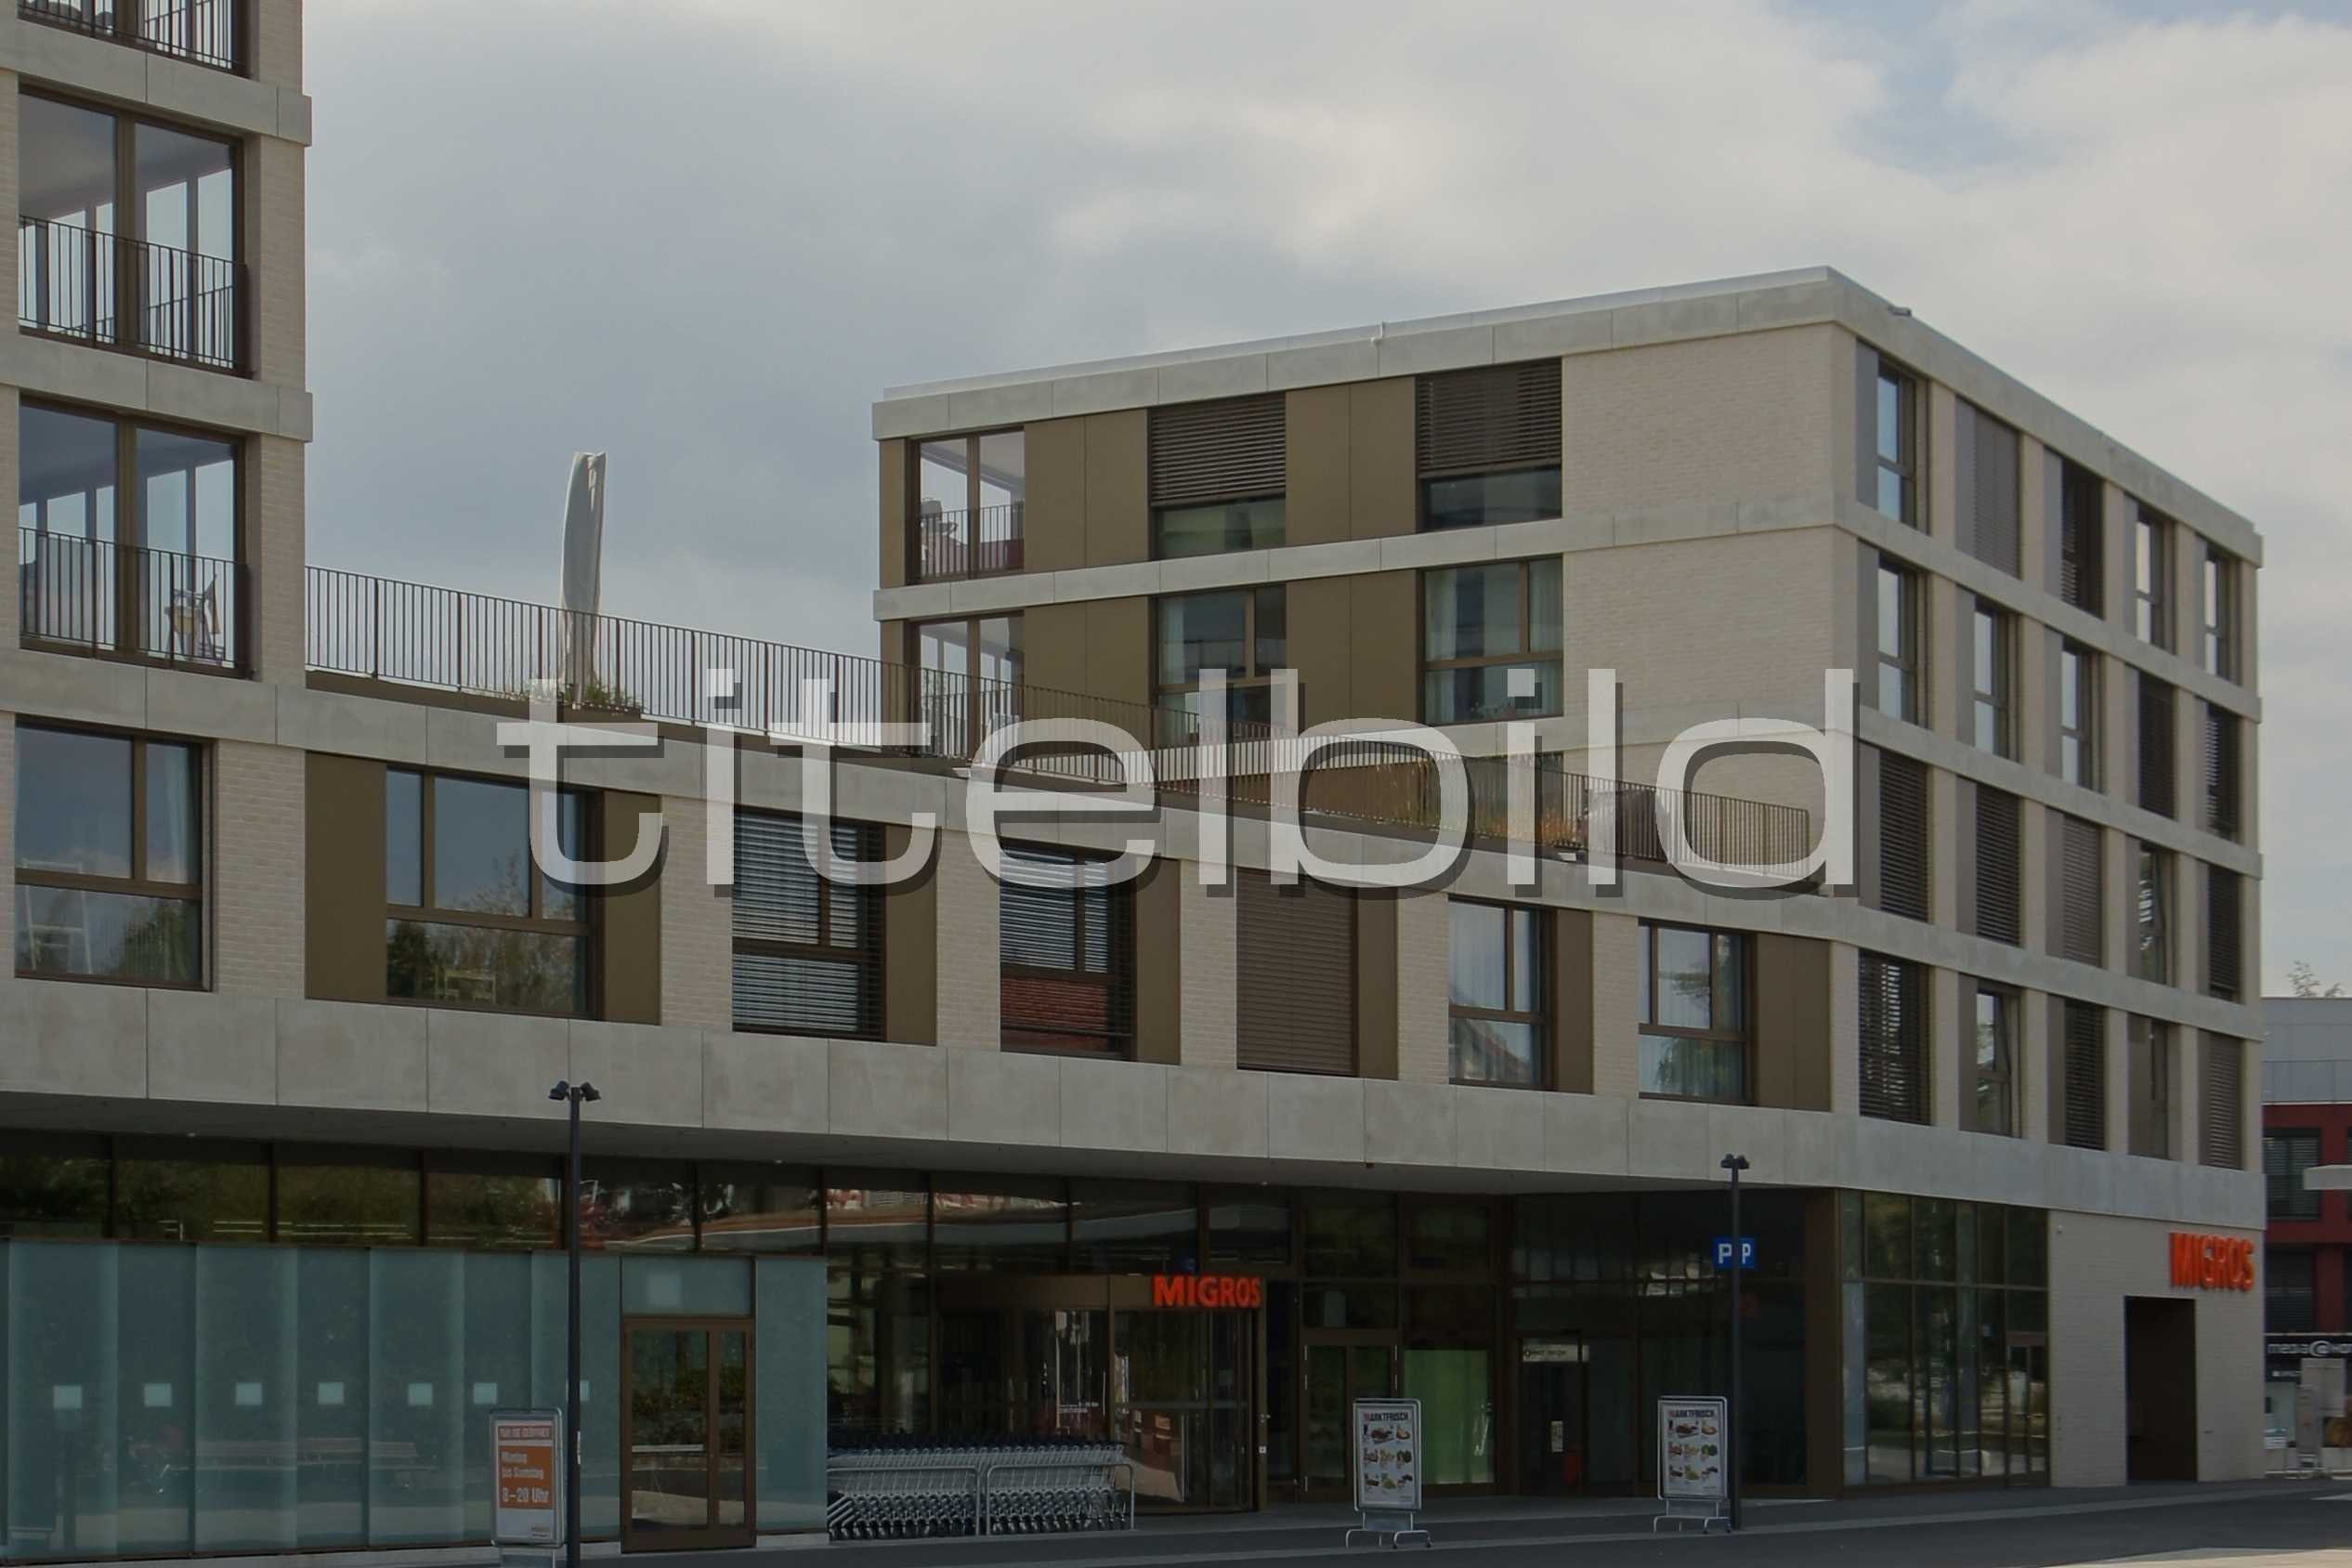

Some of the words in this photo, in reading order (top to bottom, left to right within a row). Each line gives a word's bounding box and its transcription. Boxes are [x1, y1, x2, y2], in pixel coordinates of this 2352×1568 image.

[1718, 1243, 1732, 1264] P
[1742, 1243, 1752, 1264] P
[2169, 1233, 2254, 1291] MIGROS
[1154, 1275, 1261, 1308] MIGROS
[531, 1486, 550, 1503] Uhr
